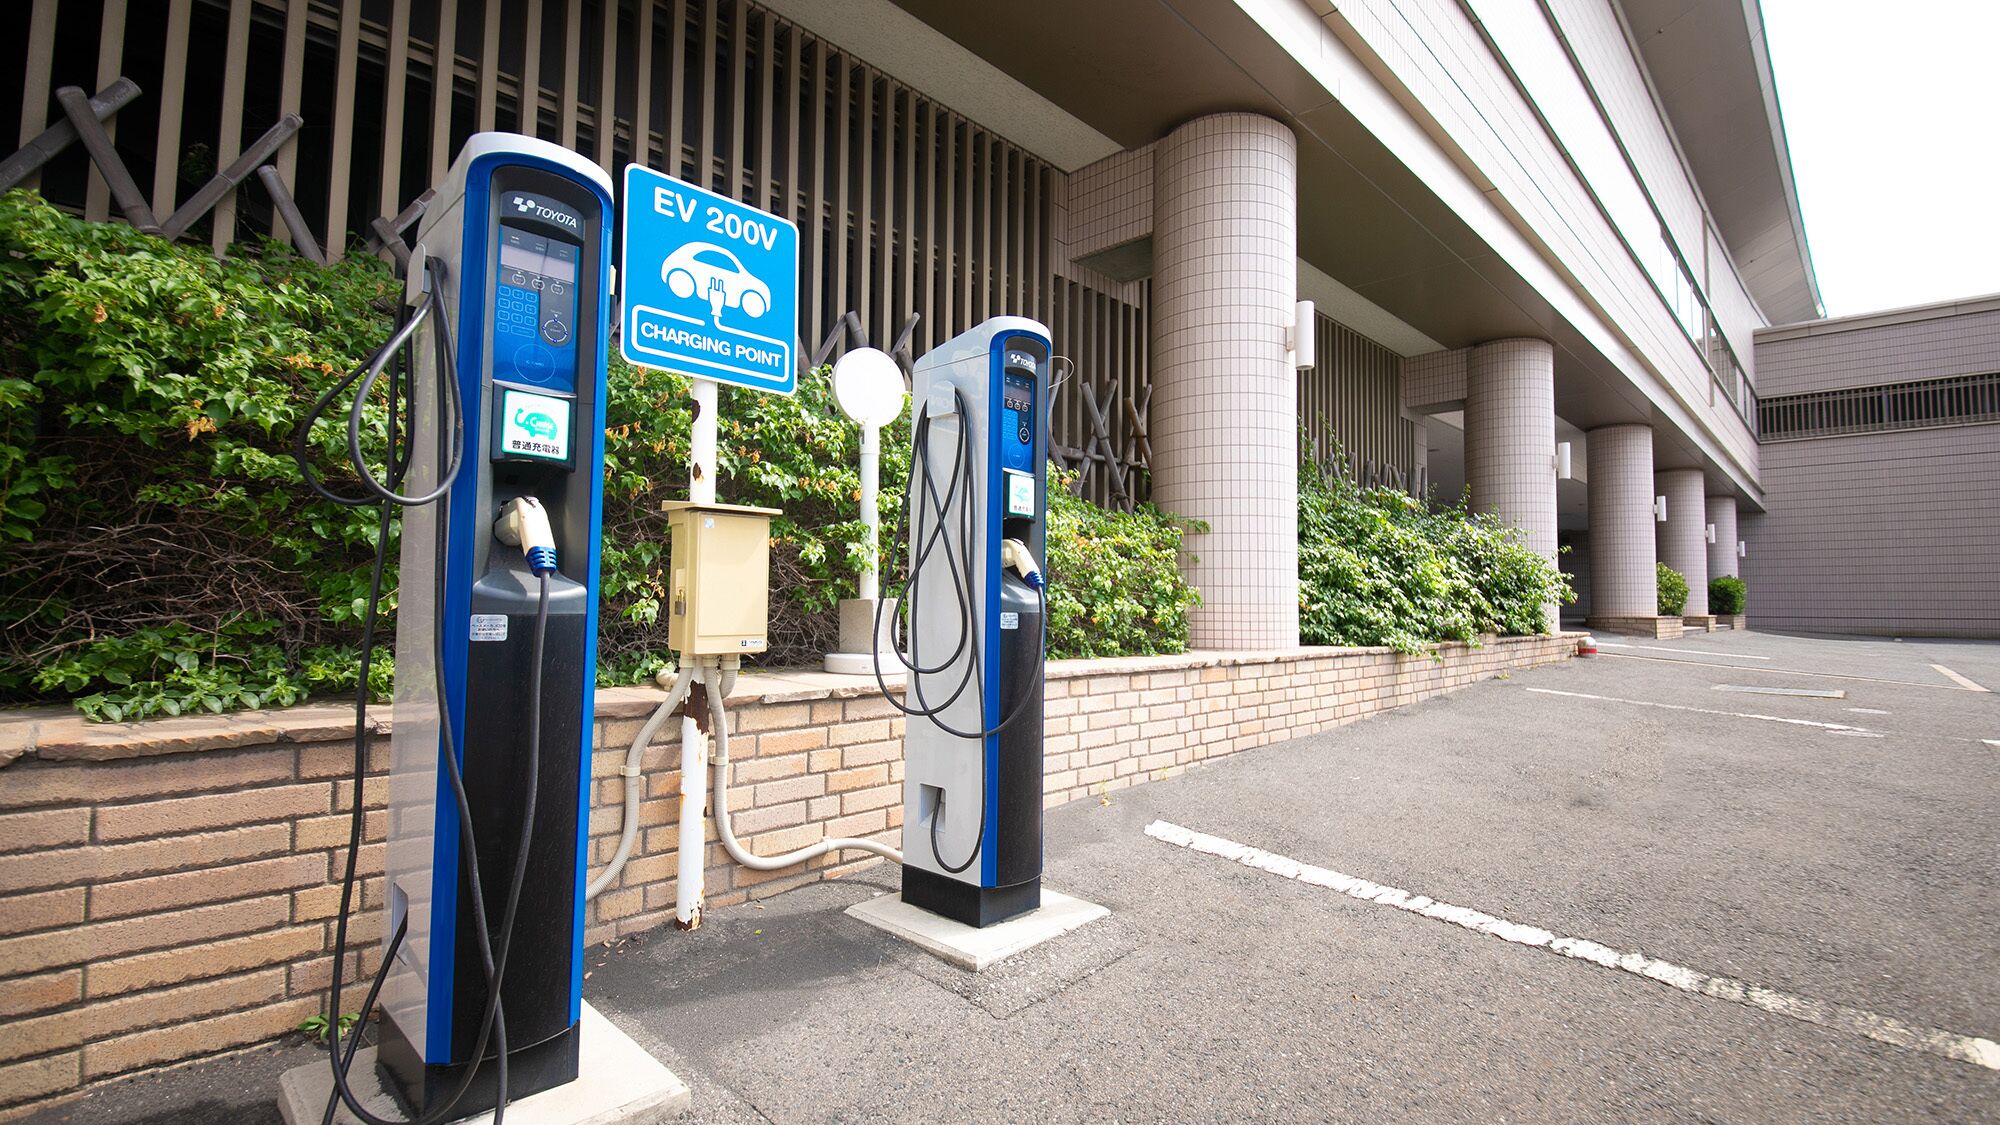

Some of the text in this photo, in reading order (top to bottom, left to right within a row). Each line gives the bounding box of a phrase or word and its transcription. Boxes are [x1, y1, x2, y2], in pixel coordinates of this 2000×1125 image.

[536, 205, 577, 229] TOYOTA
[654, 186, 778, 251] EV 200V
[640, 322, 782, 367] CHARGING POINT
[511, 440, 560, 455] 普通充電器
